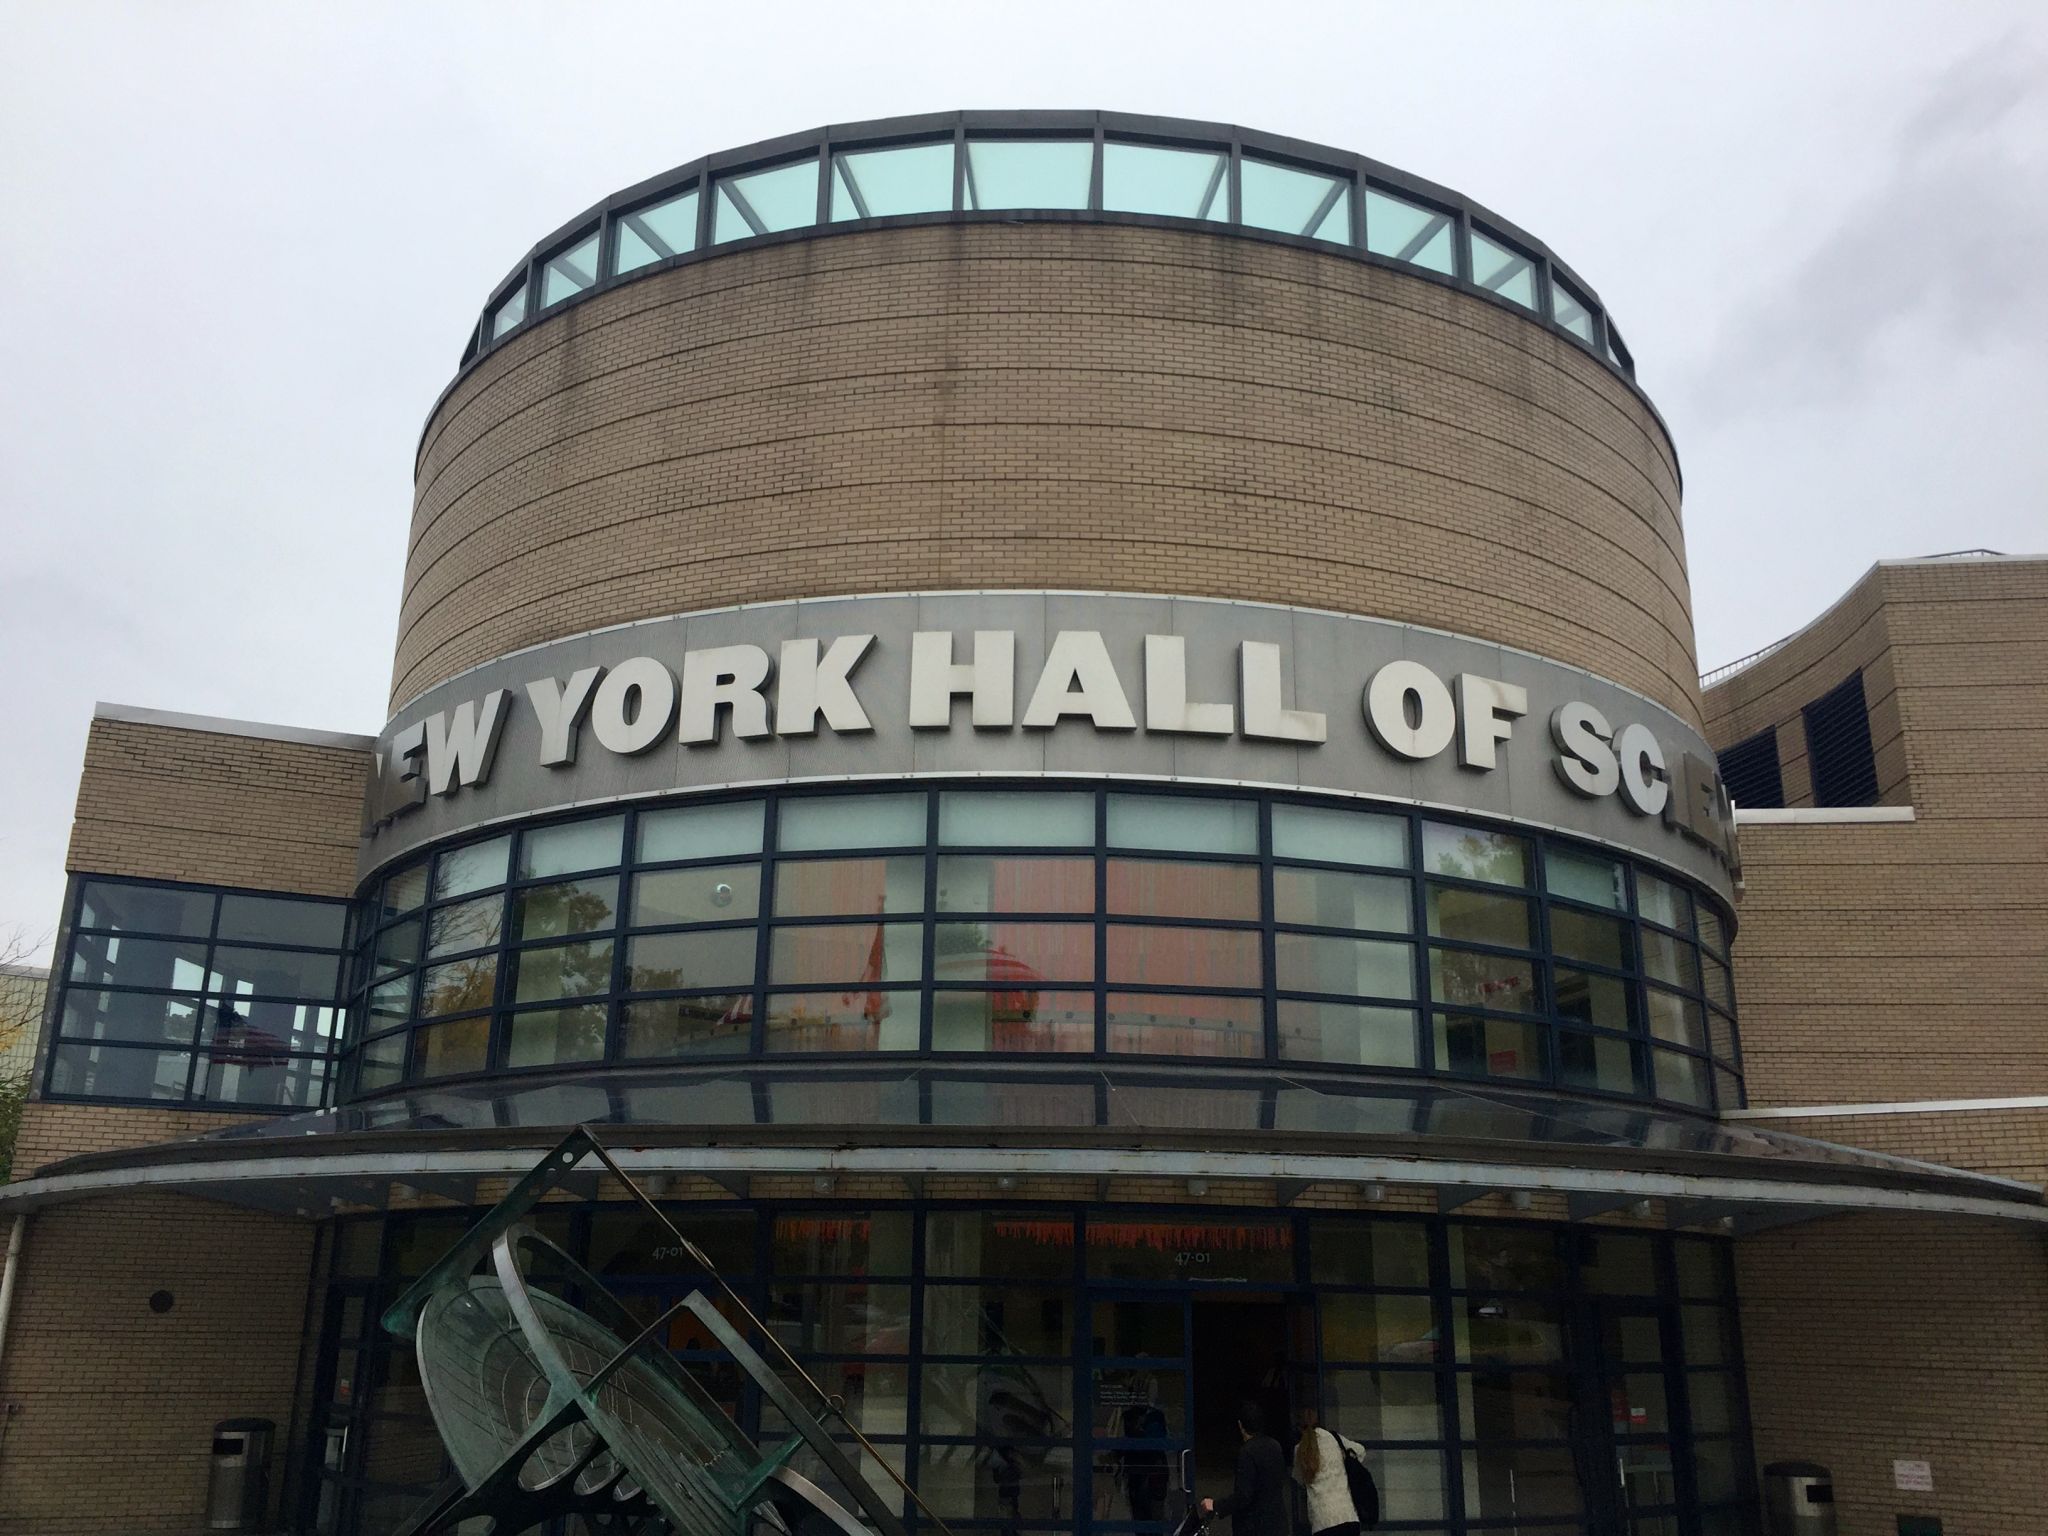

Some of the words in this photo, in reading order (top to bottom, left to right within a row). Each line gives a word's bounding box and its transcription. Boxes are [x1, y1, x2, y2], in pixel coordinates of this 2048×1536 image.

[526, 634, 877, 769] YORK
[909, 630, 1327, 745] HALL
[1363, 660, 1528, 773] OF
